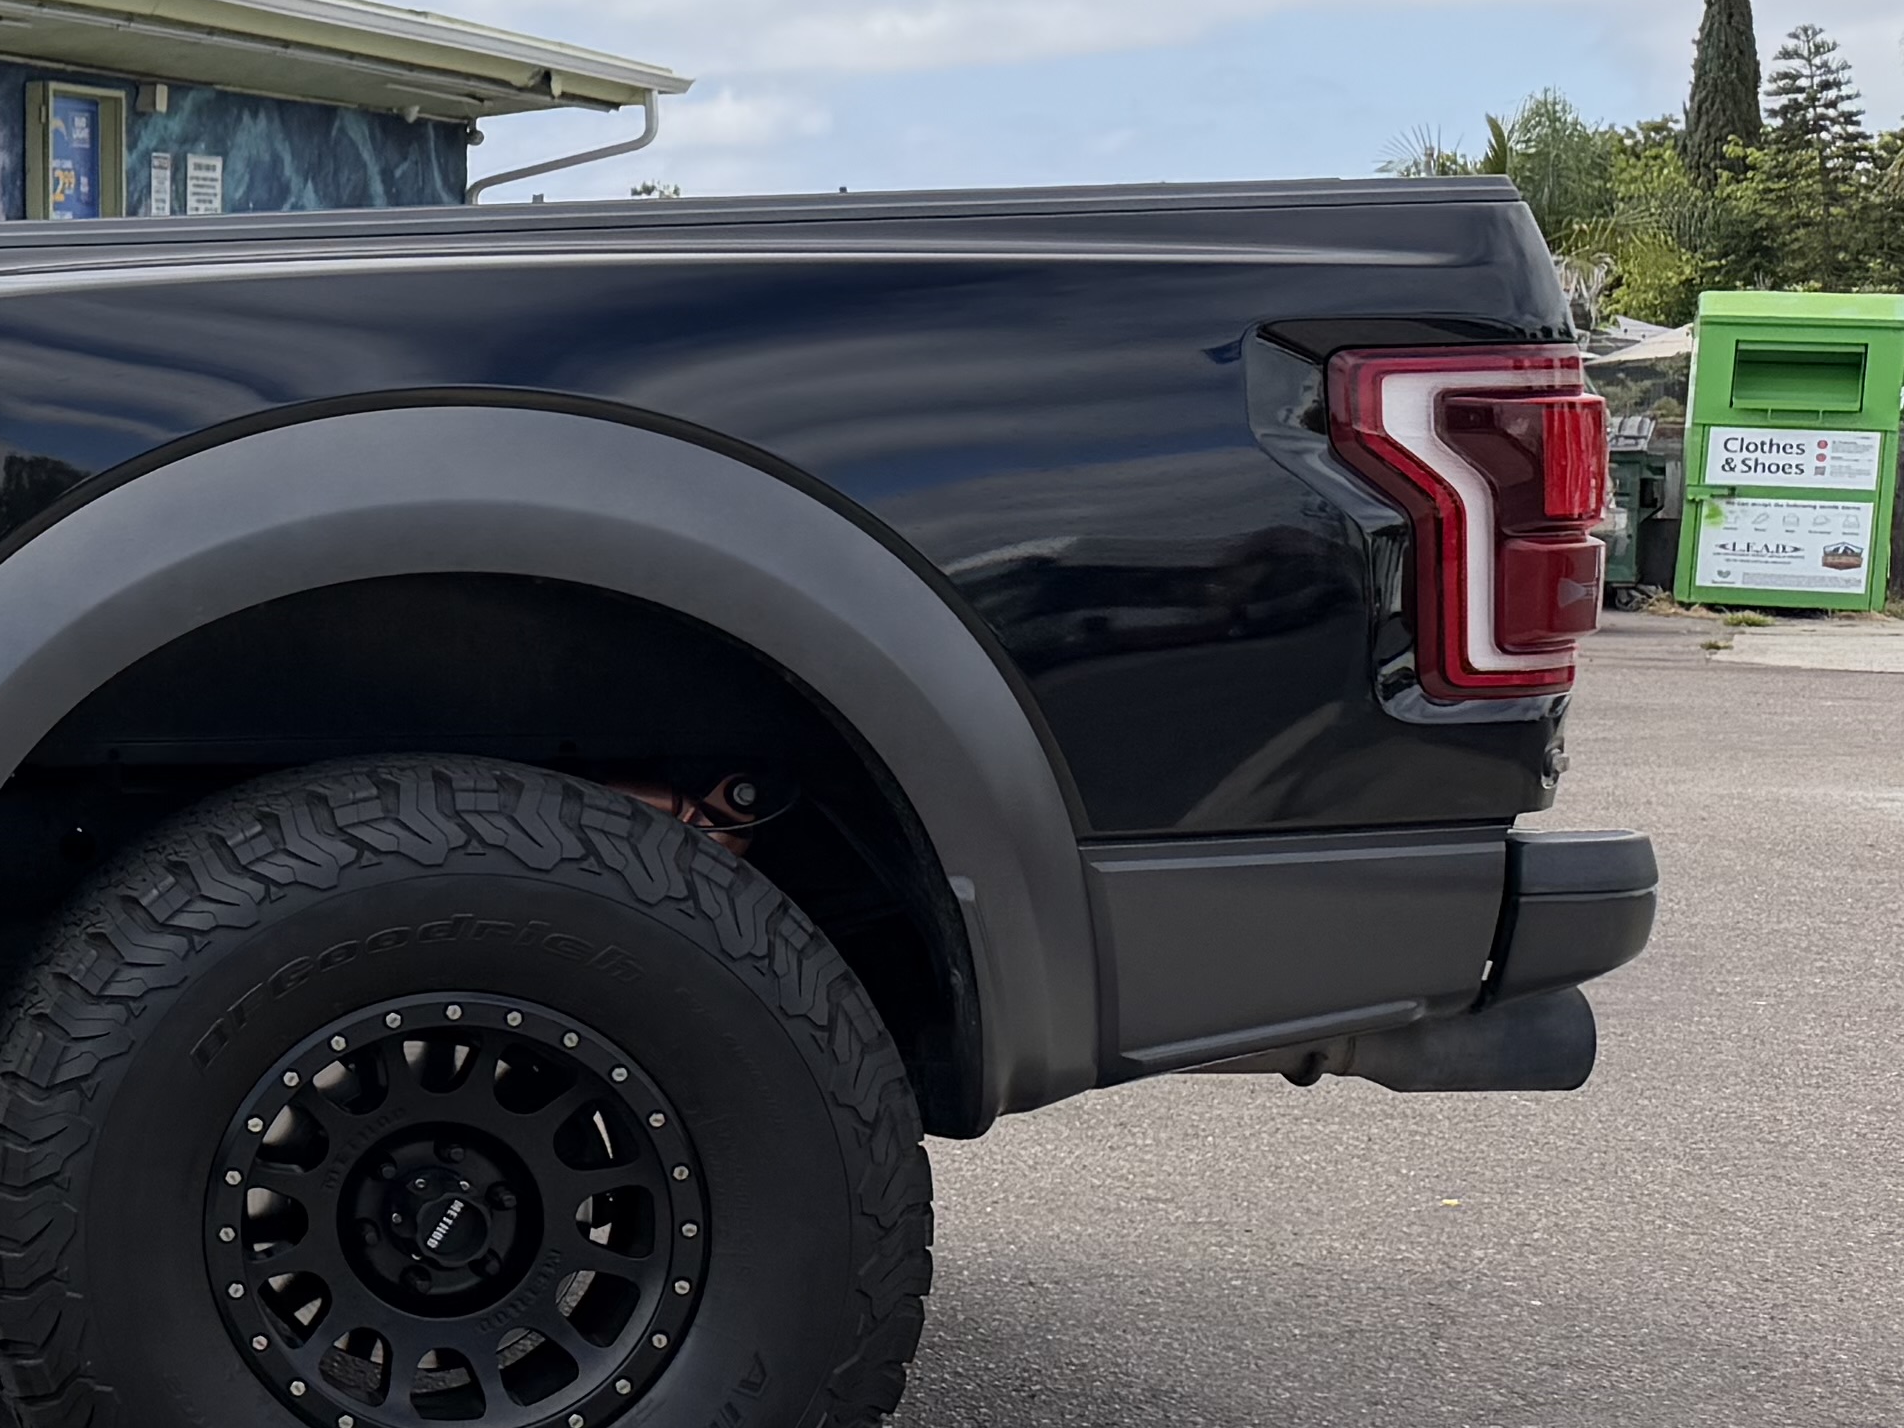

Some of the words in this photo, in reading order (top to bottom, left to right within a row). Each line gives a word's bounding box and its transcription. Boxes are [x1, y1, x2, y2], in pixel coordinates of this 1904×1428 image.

[1723, 437, 1806, 455] Clothes
[1721, 457, 1737, 473] &
[1741, 457, 1805, 476] Shoes
[427, 1199, 464, 1249] METHOD
